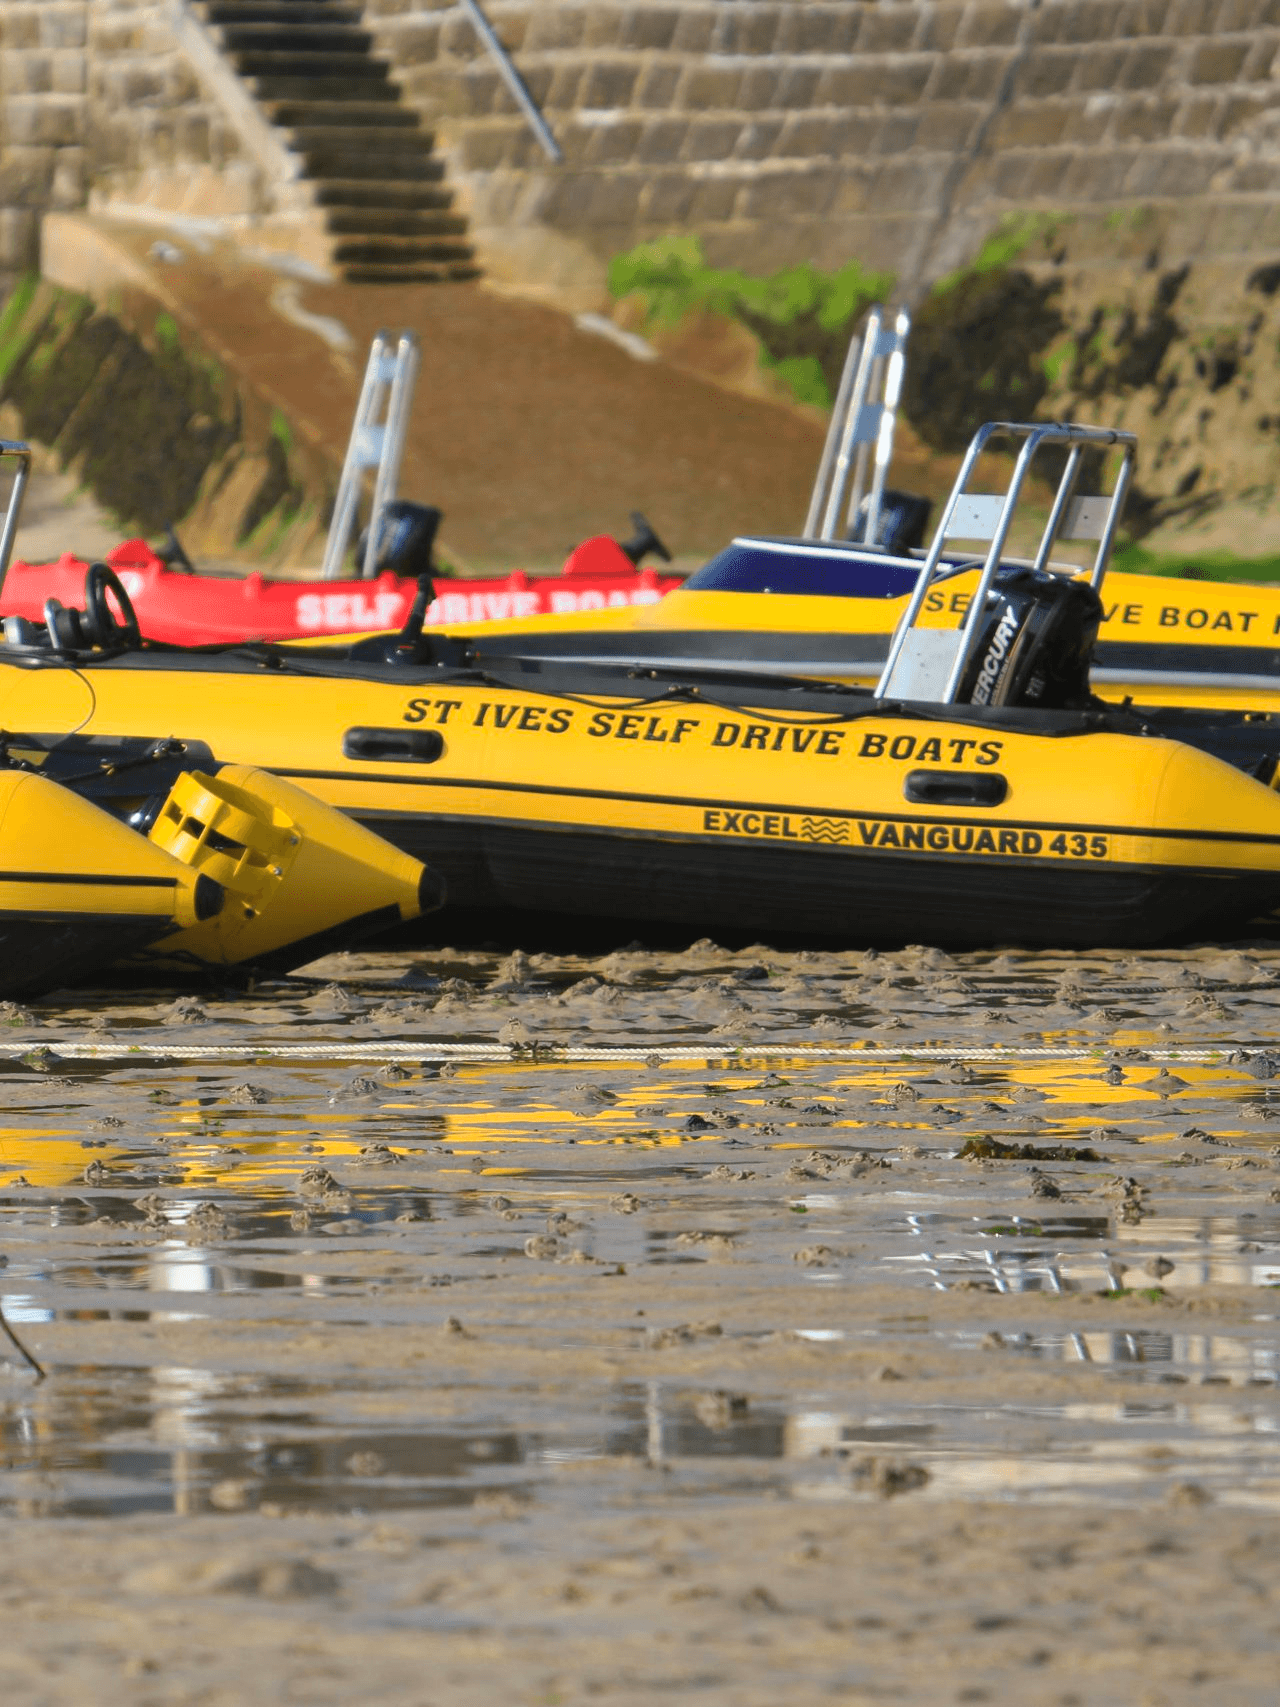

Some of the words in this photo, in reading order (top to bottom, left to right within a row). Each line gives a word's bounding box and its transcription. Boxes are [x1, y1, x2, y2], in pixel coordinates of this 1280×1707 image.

[296, 593, 403, 628] SELF
[925, 591, 970, 613] SE
[1158, 606, 1259, 632] BOAT
[970, 604, 1018, 704] ERCURY
[402, 698, 464, 724] ST
[473, 703, 573, 733] IVES
[587, 713, 700, 743] SELF
[711, 722, 845, 755] DRIVE
[858, 734, 1004, 765] BOATS
[703, 810, 798, 838] EXCEL
[858, 822, 1042, 855] VANGUARD
[1049, 835, 1109, 858] 435
